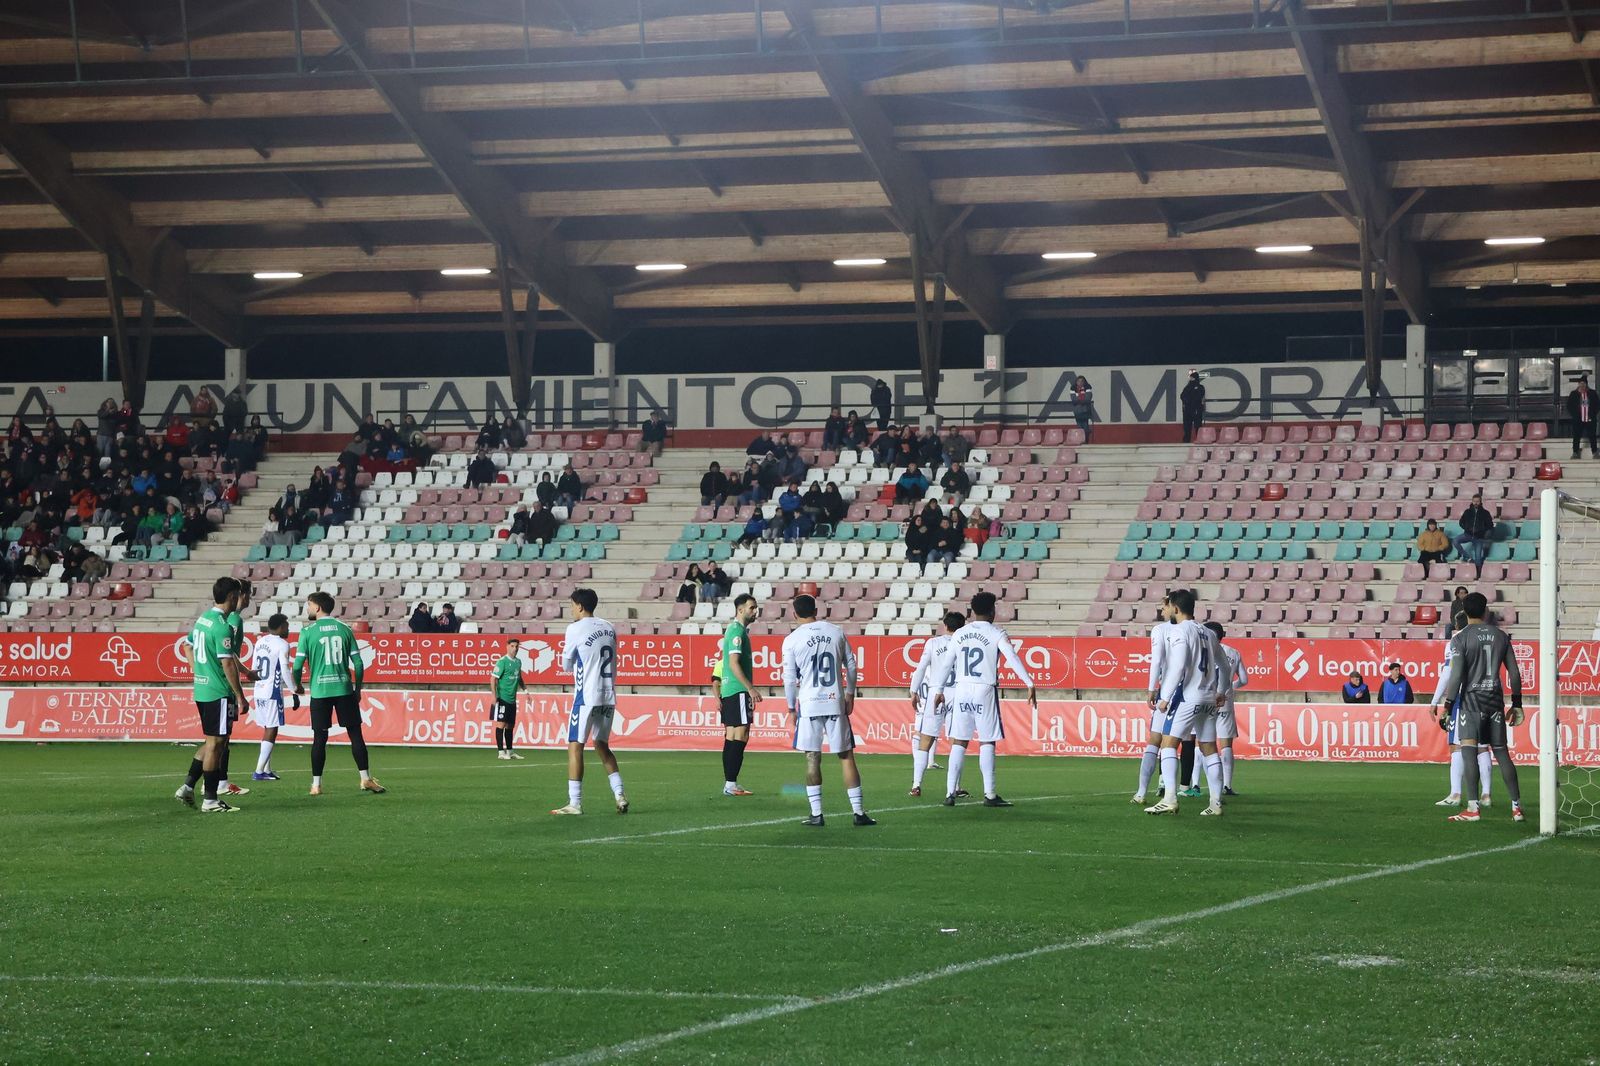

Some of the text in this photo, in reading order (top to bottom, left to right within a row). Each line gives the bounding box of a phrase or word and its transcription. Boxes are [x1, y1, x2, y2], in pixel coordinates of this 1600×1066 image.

[830, 373, 945, 426] DE
[973, 366, 1402, 424] ZAMORA
[9, 635, 72, 660] salud
[585, 629, 603, 647] DAVID
[806, 635, 832, 648] CÉSAR
[957, 632, 990, 647] LANDAZURI
[319, 635, 343, 666] 18
[377, 650, 502, 667] tres cruces
[1483, 644, 1492, 676] 1
[0, 665, 72, 677] ZAMORA
[600, 645, 614, 678] 2
[810, 651, 836, 688] 19
[960, 646, 984, 678] 12
[63, 692, 167, 708] TERNERA
[406, 695, 484, 712] CLÍNICA
[403, 714, 569, 744] JOSÉ DE AULA
[669, 729, 699, 737] CENTRO
[1030, 705, 1066, 742] La
[1248, 706, 1419, 759] La Opinión
[1042, 743, 1054, 753] El
[1056, 743, 1098, 753] Correo
[1110, 743, 1124, 753] de
[1260, 747, 1400, 759] El Correo de Zamora
